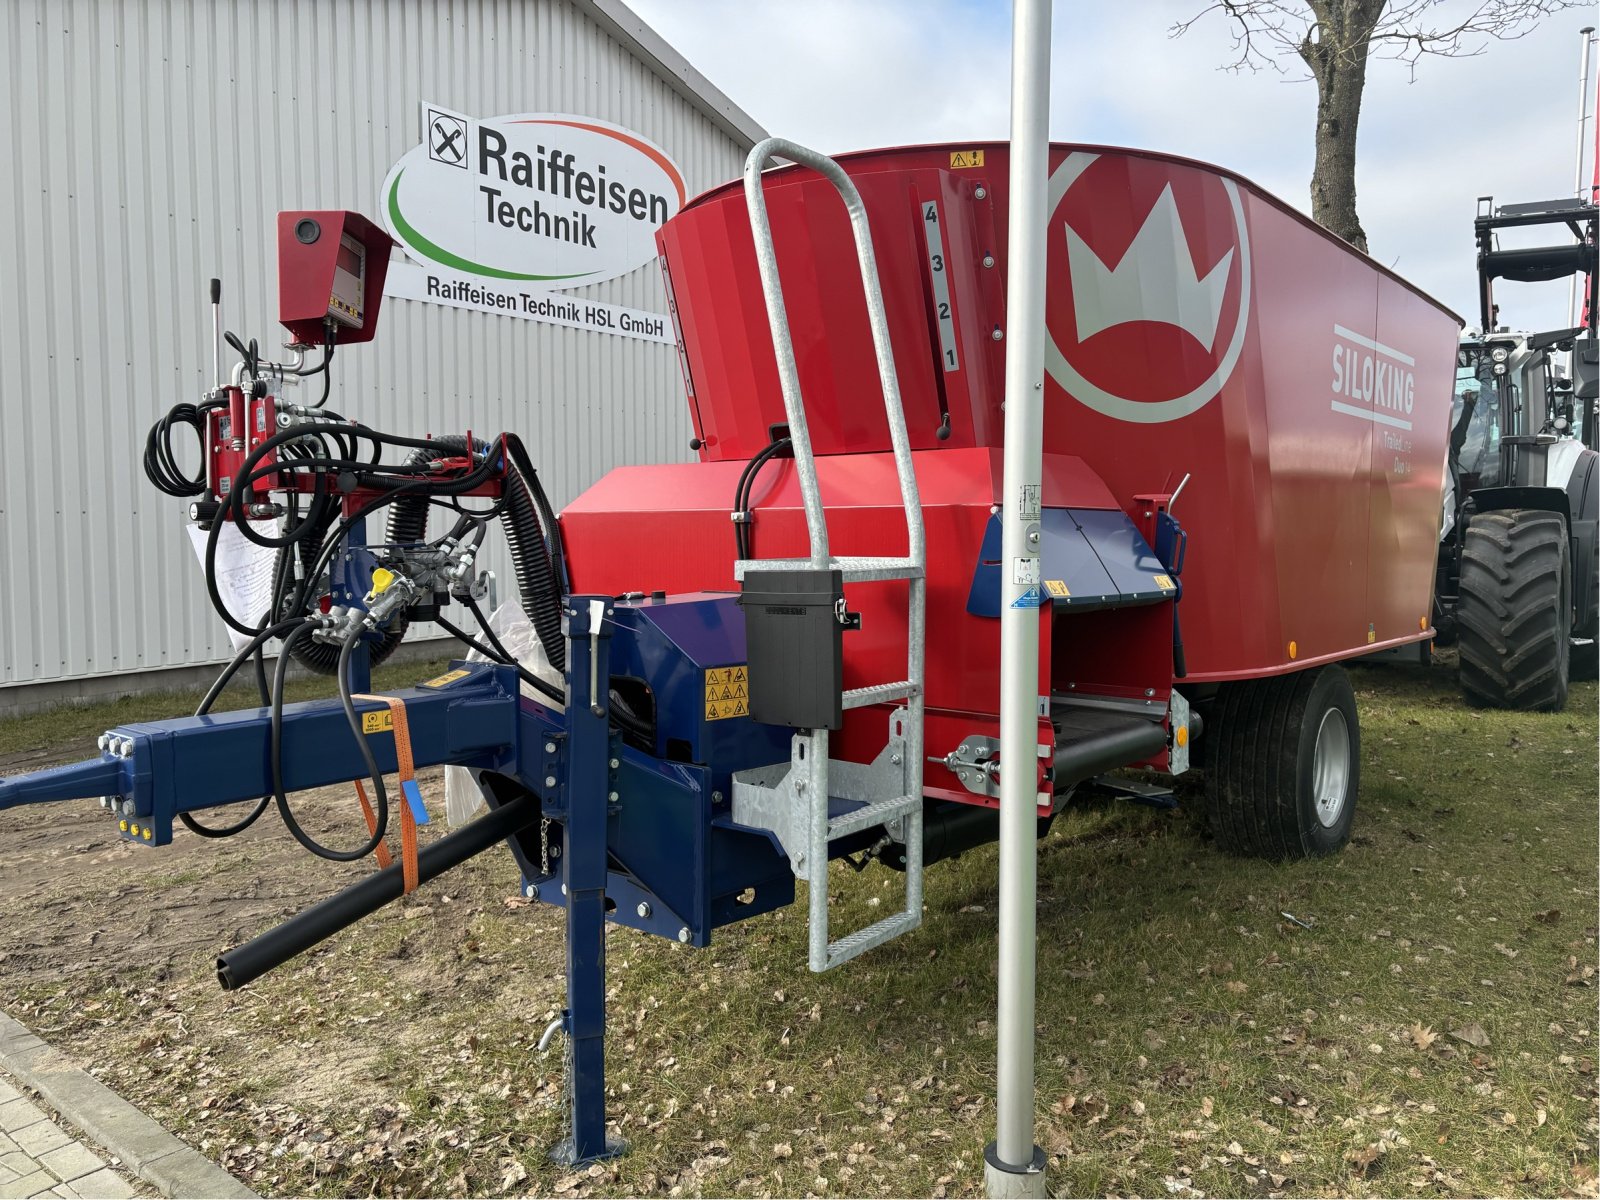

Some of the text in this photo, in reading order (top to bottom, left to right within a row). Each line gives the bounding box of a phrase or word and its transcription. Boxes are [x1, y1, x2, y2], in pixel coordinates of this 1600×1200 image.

[478, 125, 668, 225] Raiffeisen
[479, 185, 597, 249] Technik
[925, 205, 937, 223] 4
[931, 254, 944, 272] 3
[427, 275, 664, 337] Raiffeisen Technik HSL GmbH
[938, 302, 950, 320] 2
[946, 349, 955, 366] 1
[1331, 343, 1415, 415] SILOKING
